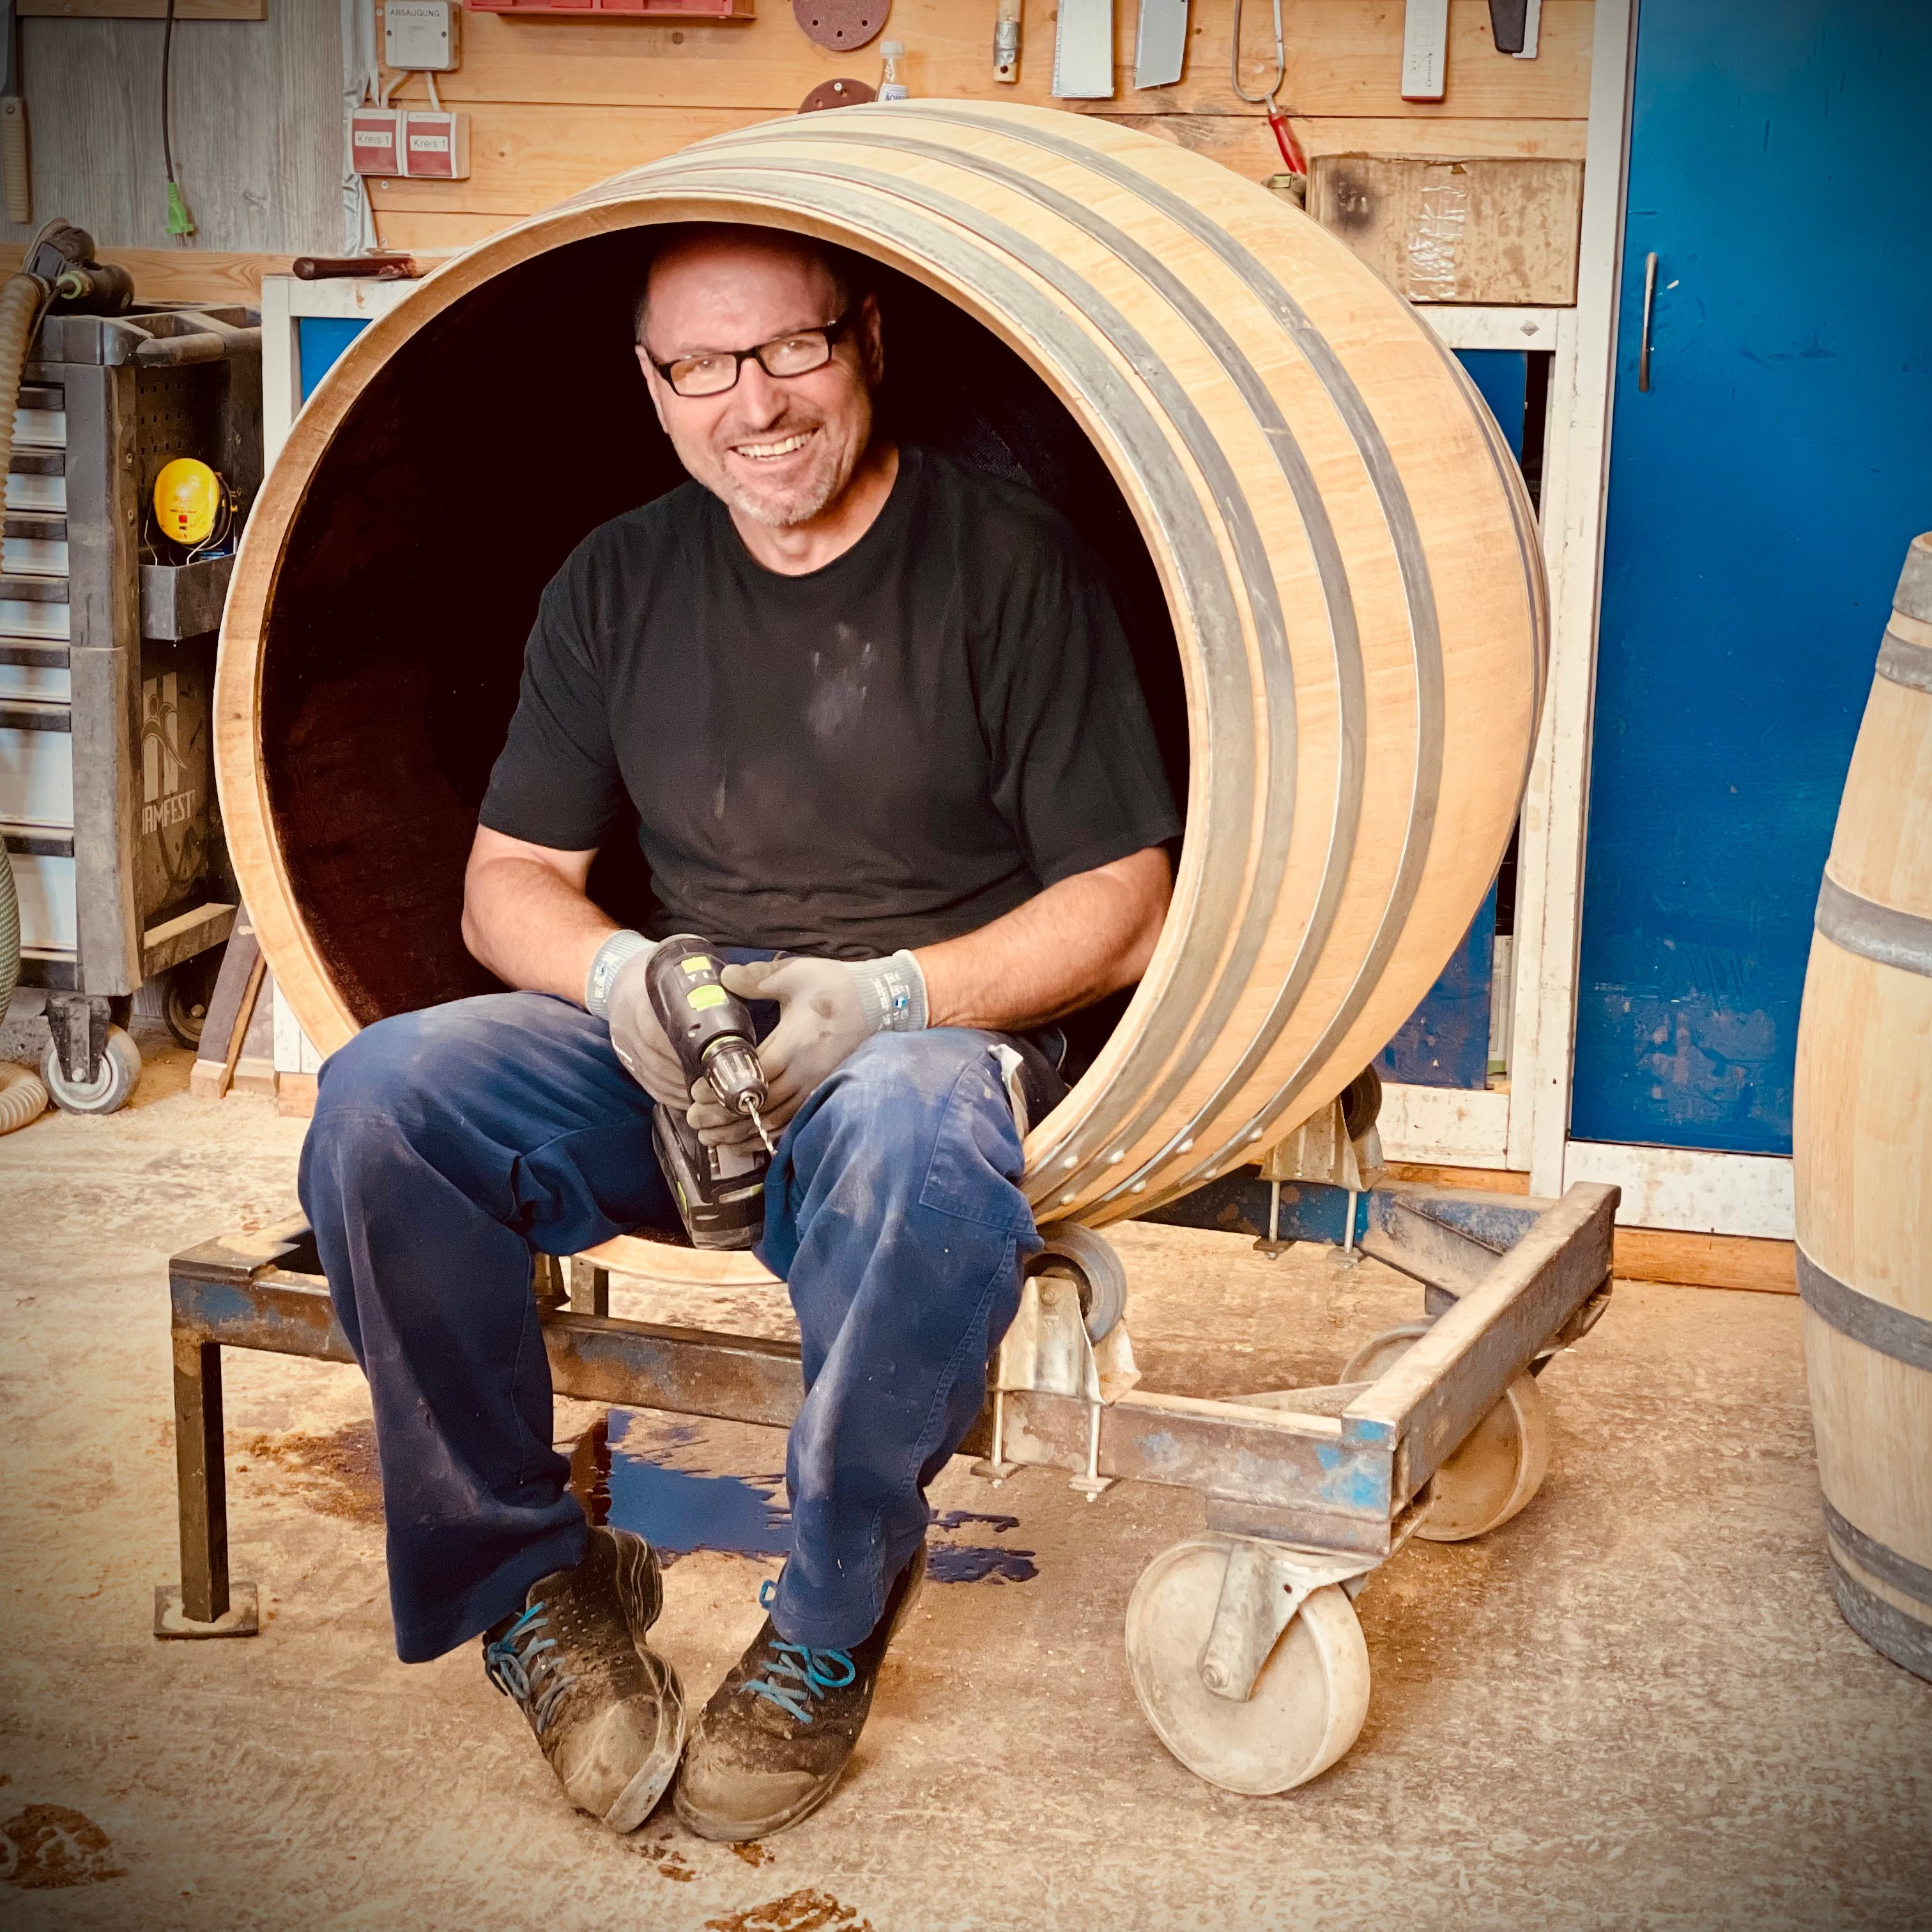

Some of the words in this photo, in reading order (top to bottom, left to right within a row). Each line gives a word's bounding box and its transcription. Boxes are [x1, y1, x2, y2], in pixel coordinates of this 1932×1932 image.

[390, 8, 440, 17] ABSAUGUNG
[357, 134, 381, 144] Kreis
[385, 135, 390, 144] 1
[413, 139, 438, 149] Kreis
[441, 139, 446, 148] 1
